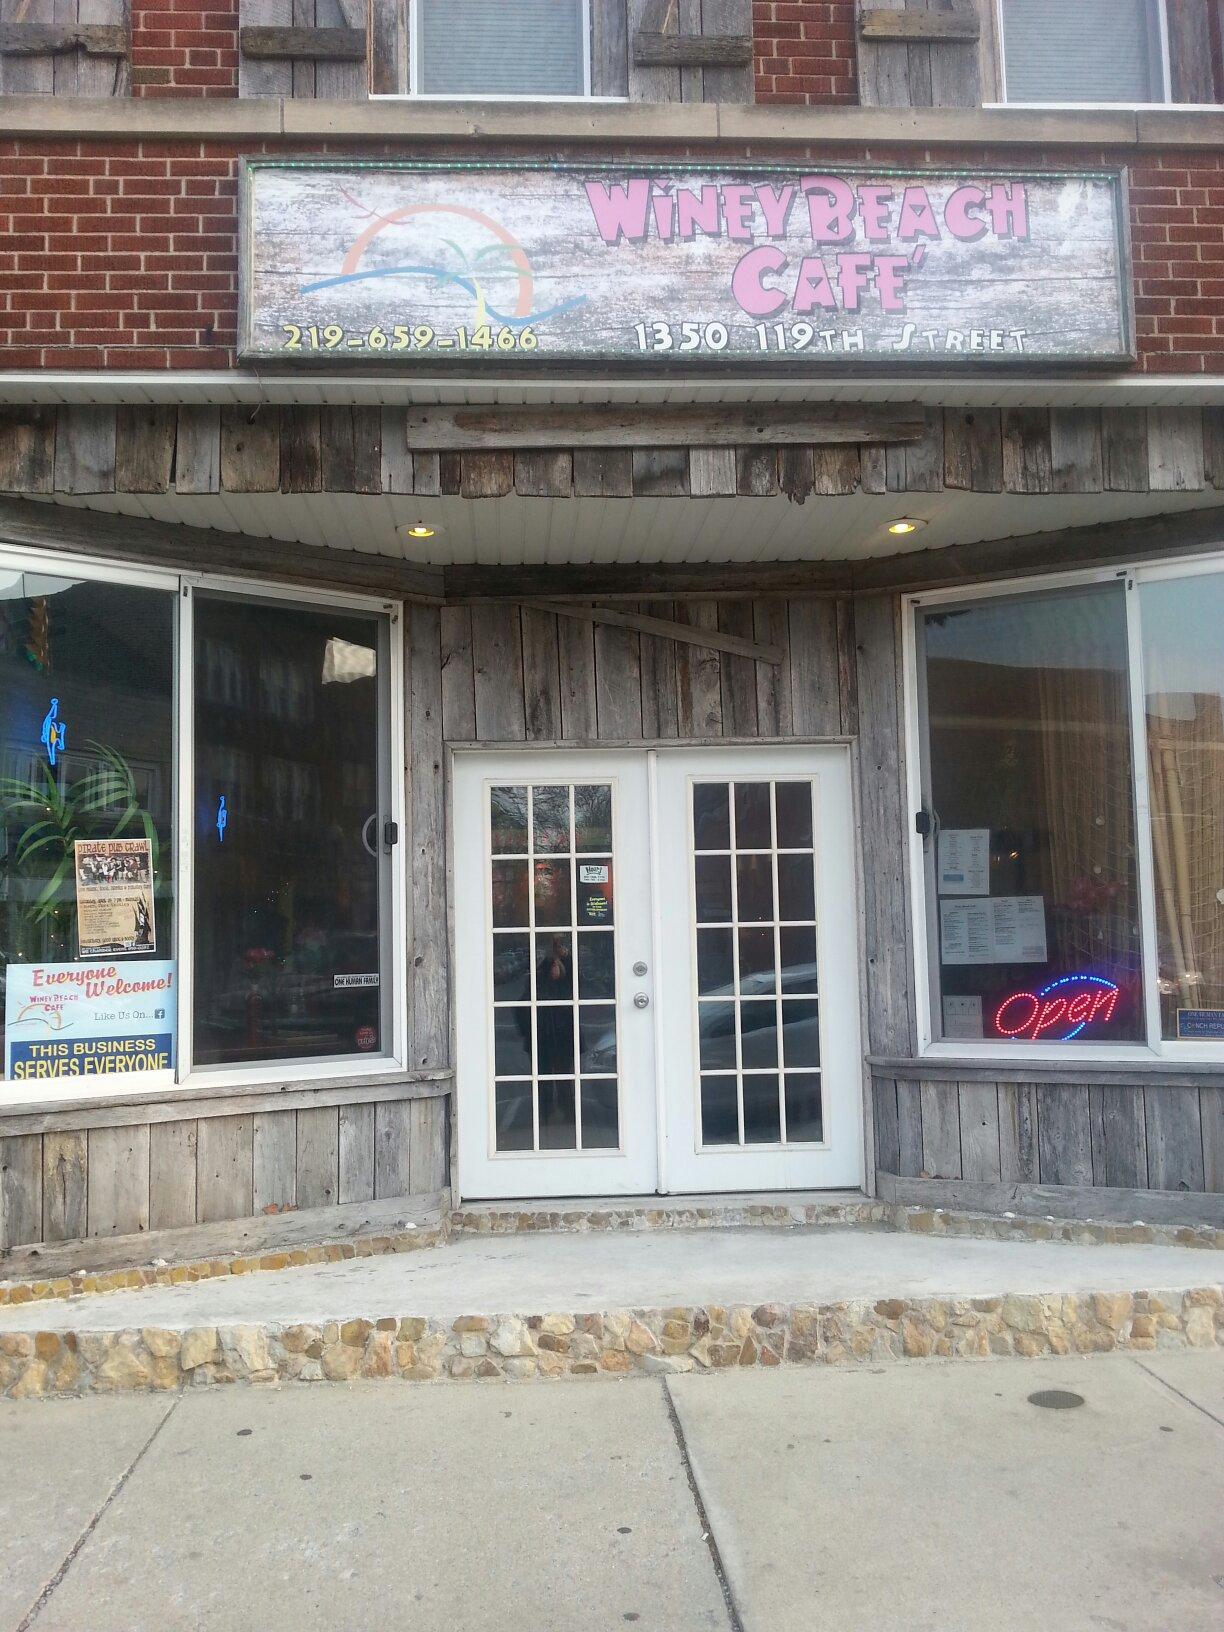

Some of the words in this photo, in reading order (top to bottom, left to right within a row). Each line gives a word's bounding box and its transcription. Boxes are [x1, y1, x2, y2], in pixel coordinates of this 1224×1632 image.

[799, 175, 1030, 244] BEACH
[281, 324, 539, 351] 219-659-1466
[635, 322, 728, 352] 1350
[756, 322, 865, 352] 119TH
[892, 321, 1028, 352] STREET
[32, 966, 118, 987] Everyone
[85, 972, 174, 999] Welcome!
[94, 1012, 116, 1021] Like
[118, 1010, 131, 1020] Us
[995, 987, 1120, 1040] Open
[29, 1043, 69, 1058] THIS
[73, 1039, 156, 1055] BUSINESS
[14, 1057, 80, 1081] SERVES
[84, 1052, 169, 1076] EVERYONE
